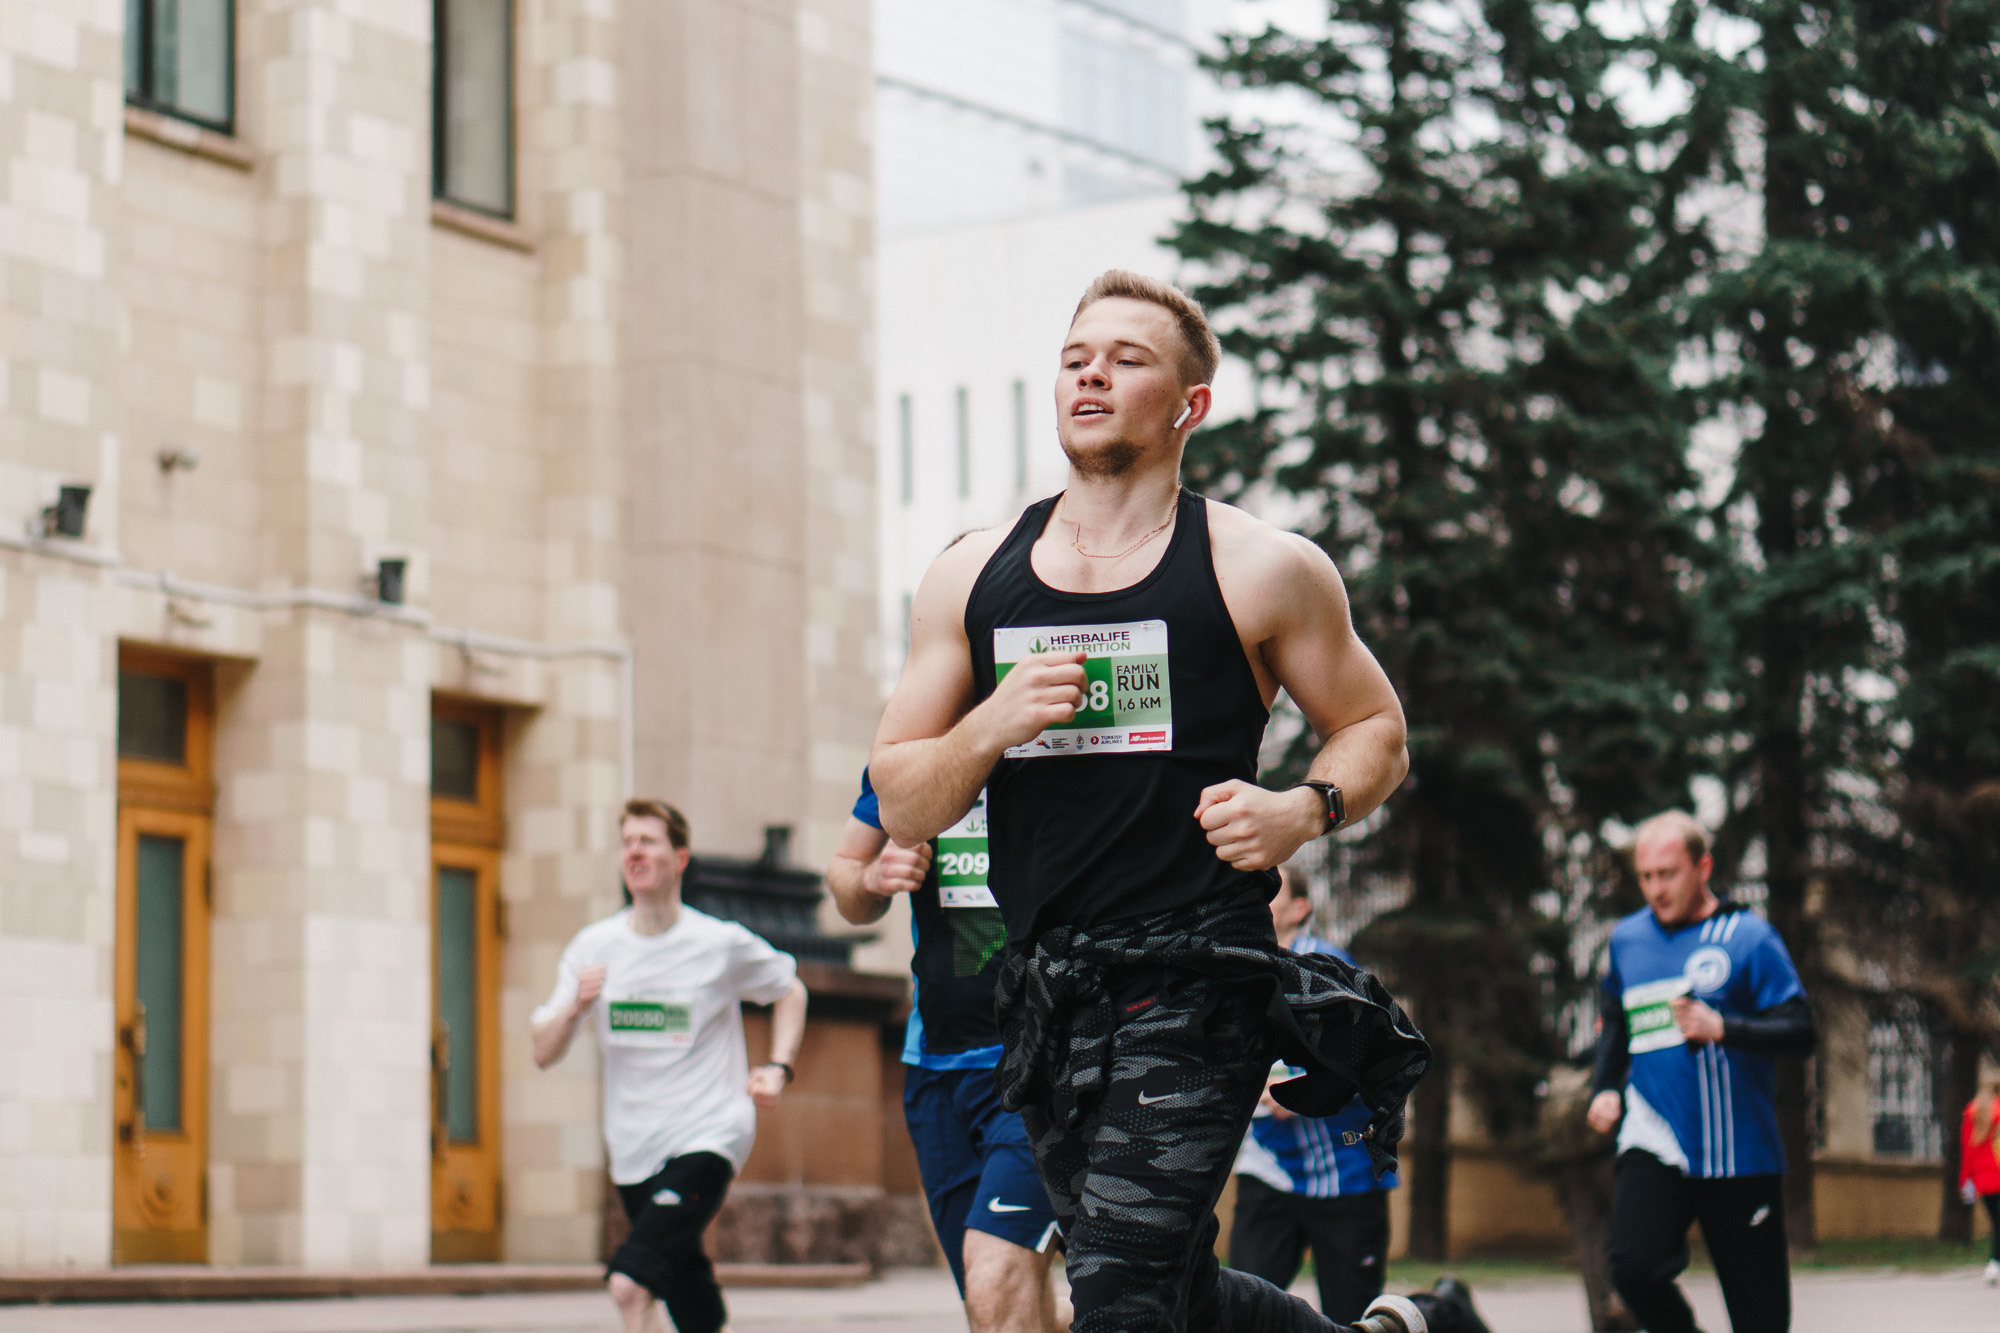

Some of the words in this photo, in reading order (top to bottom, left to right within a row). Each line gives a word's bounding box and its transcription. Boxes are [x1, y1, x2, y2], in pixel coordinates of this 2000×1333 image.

[1050, 631, 1130, 645] HERBALIFE
[1117, 663, 1158, 675] FAMILY
[1117, 673, 1160, 691] RUN
[1118, 698, 1135, 712] 1,6
[1140, 696, 1161, 709] KM
